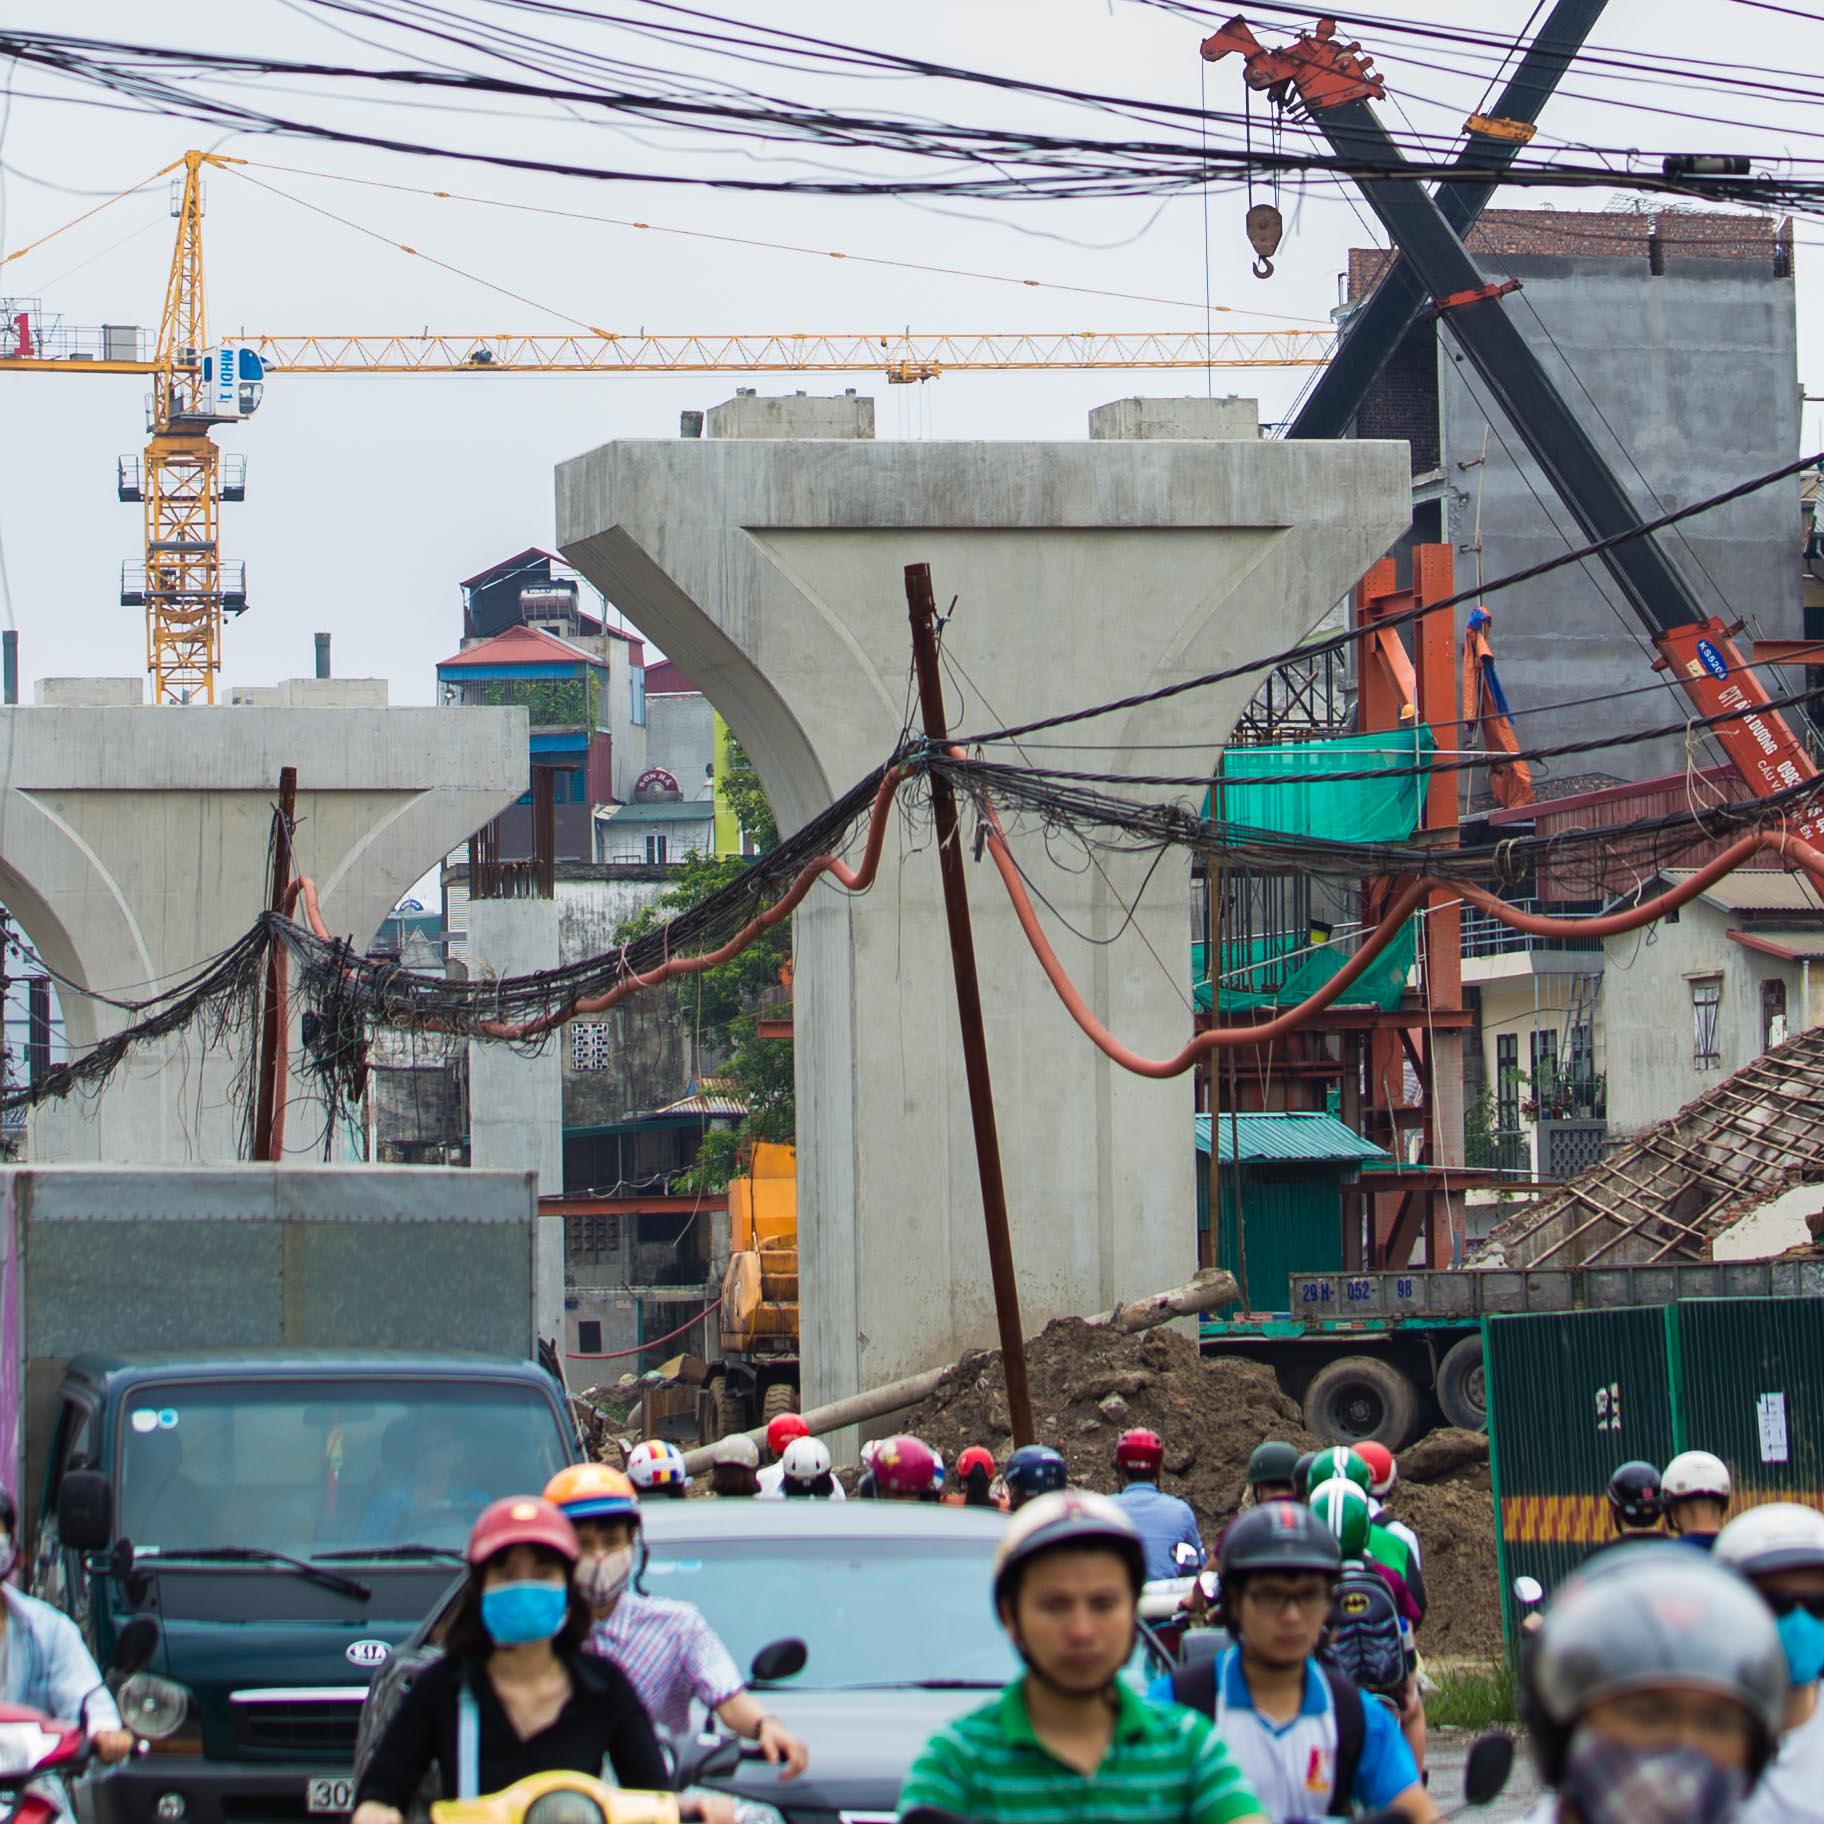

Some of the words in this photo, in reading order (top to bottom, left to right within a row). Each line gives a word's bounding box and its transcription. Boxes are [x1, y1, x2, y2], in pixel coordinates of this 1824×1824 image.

[220, 349, 234, 387] MHDI
[1734, 699, 1758, 724] ÁH
[1397, 1279, 1412, 1298] 98
